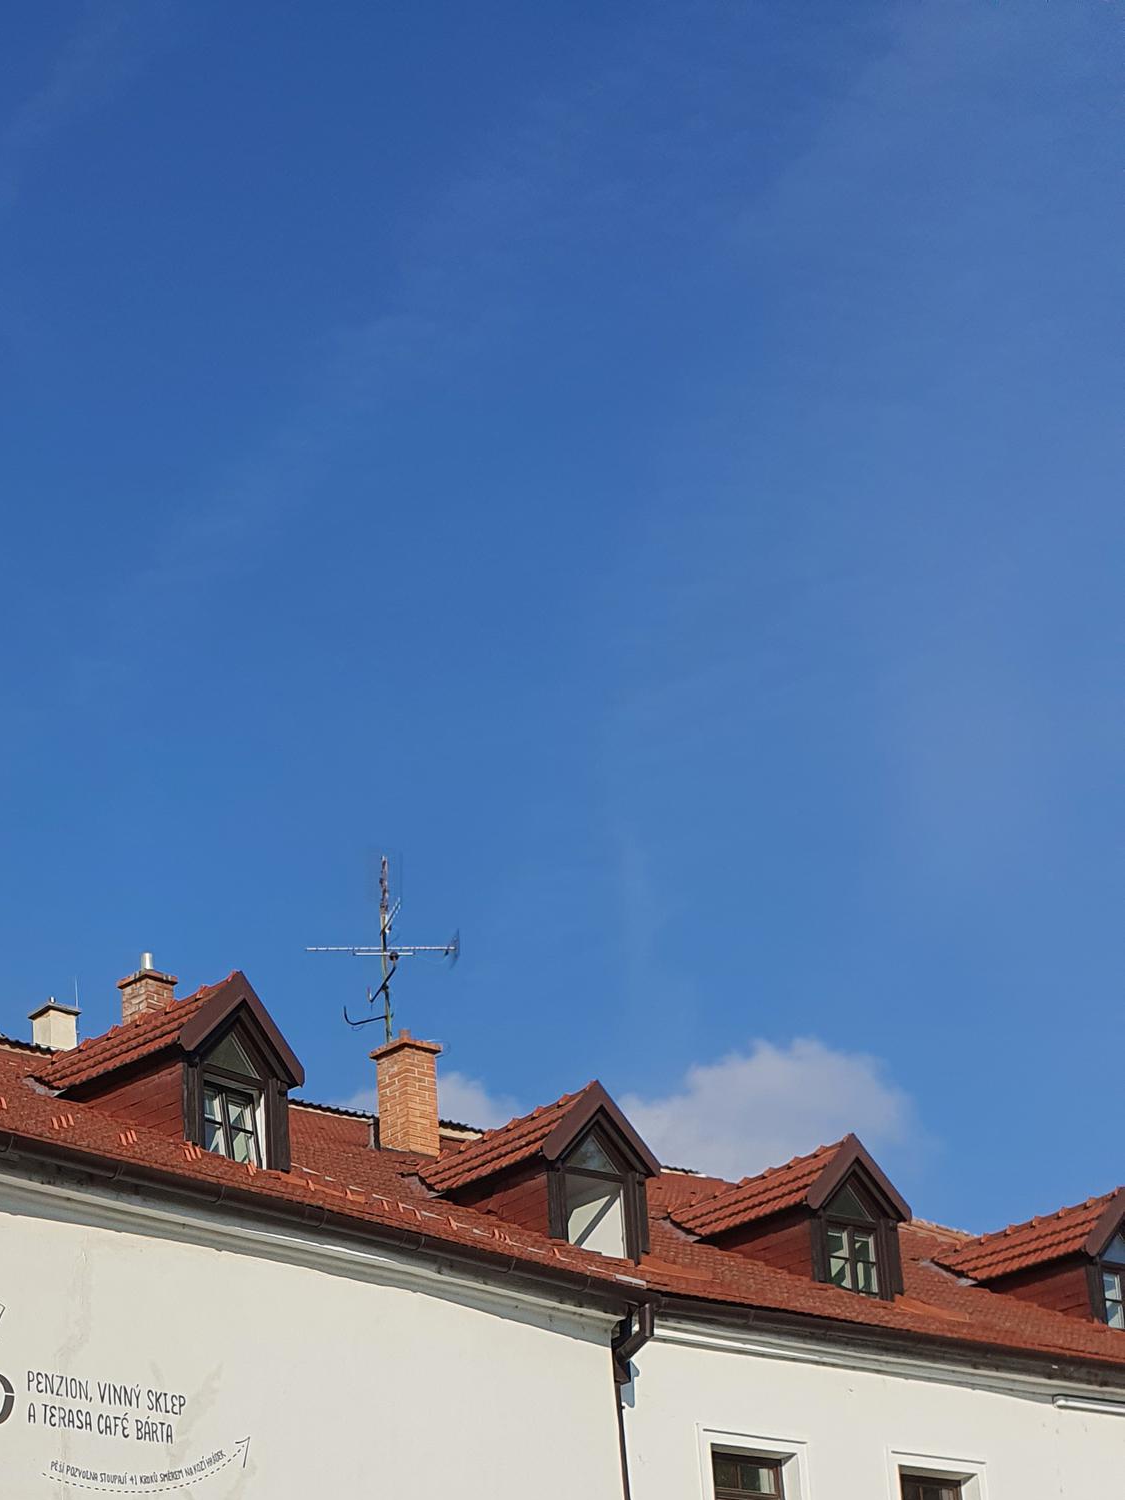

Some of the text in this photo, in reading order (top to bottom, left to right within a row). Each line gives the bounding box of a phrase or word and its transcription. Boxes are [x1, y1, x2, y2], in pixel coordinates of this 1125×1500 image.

[27, 1370, 187, 1416] PENZION, VINNÝ SKLEP
[28, 1402, 173, 1444] A TERASA CAFÉ BÁRTA
[66, 1465, 98, 1482] POZVOLNA
[99, 1472, 128, 1485] STOUPAJÍ
[129, 1475, 138, 1485] 41
[139, 1471, 159, 1485] KROKŮ
[185, 1467, 194, 1477] NA
[194, 1456, 207, 1474] KOZÍ
